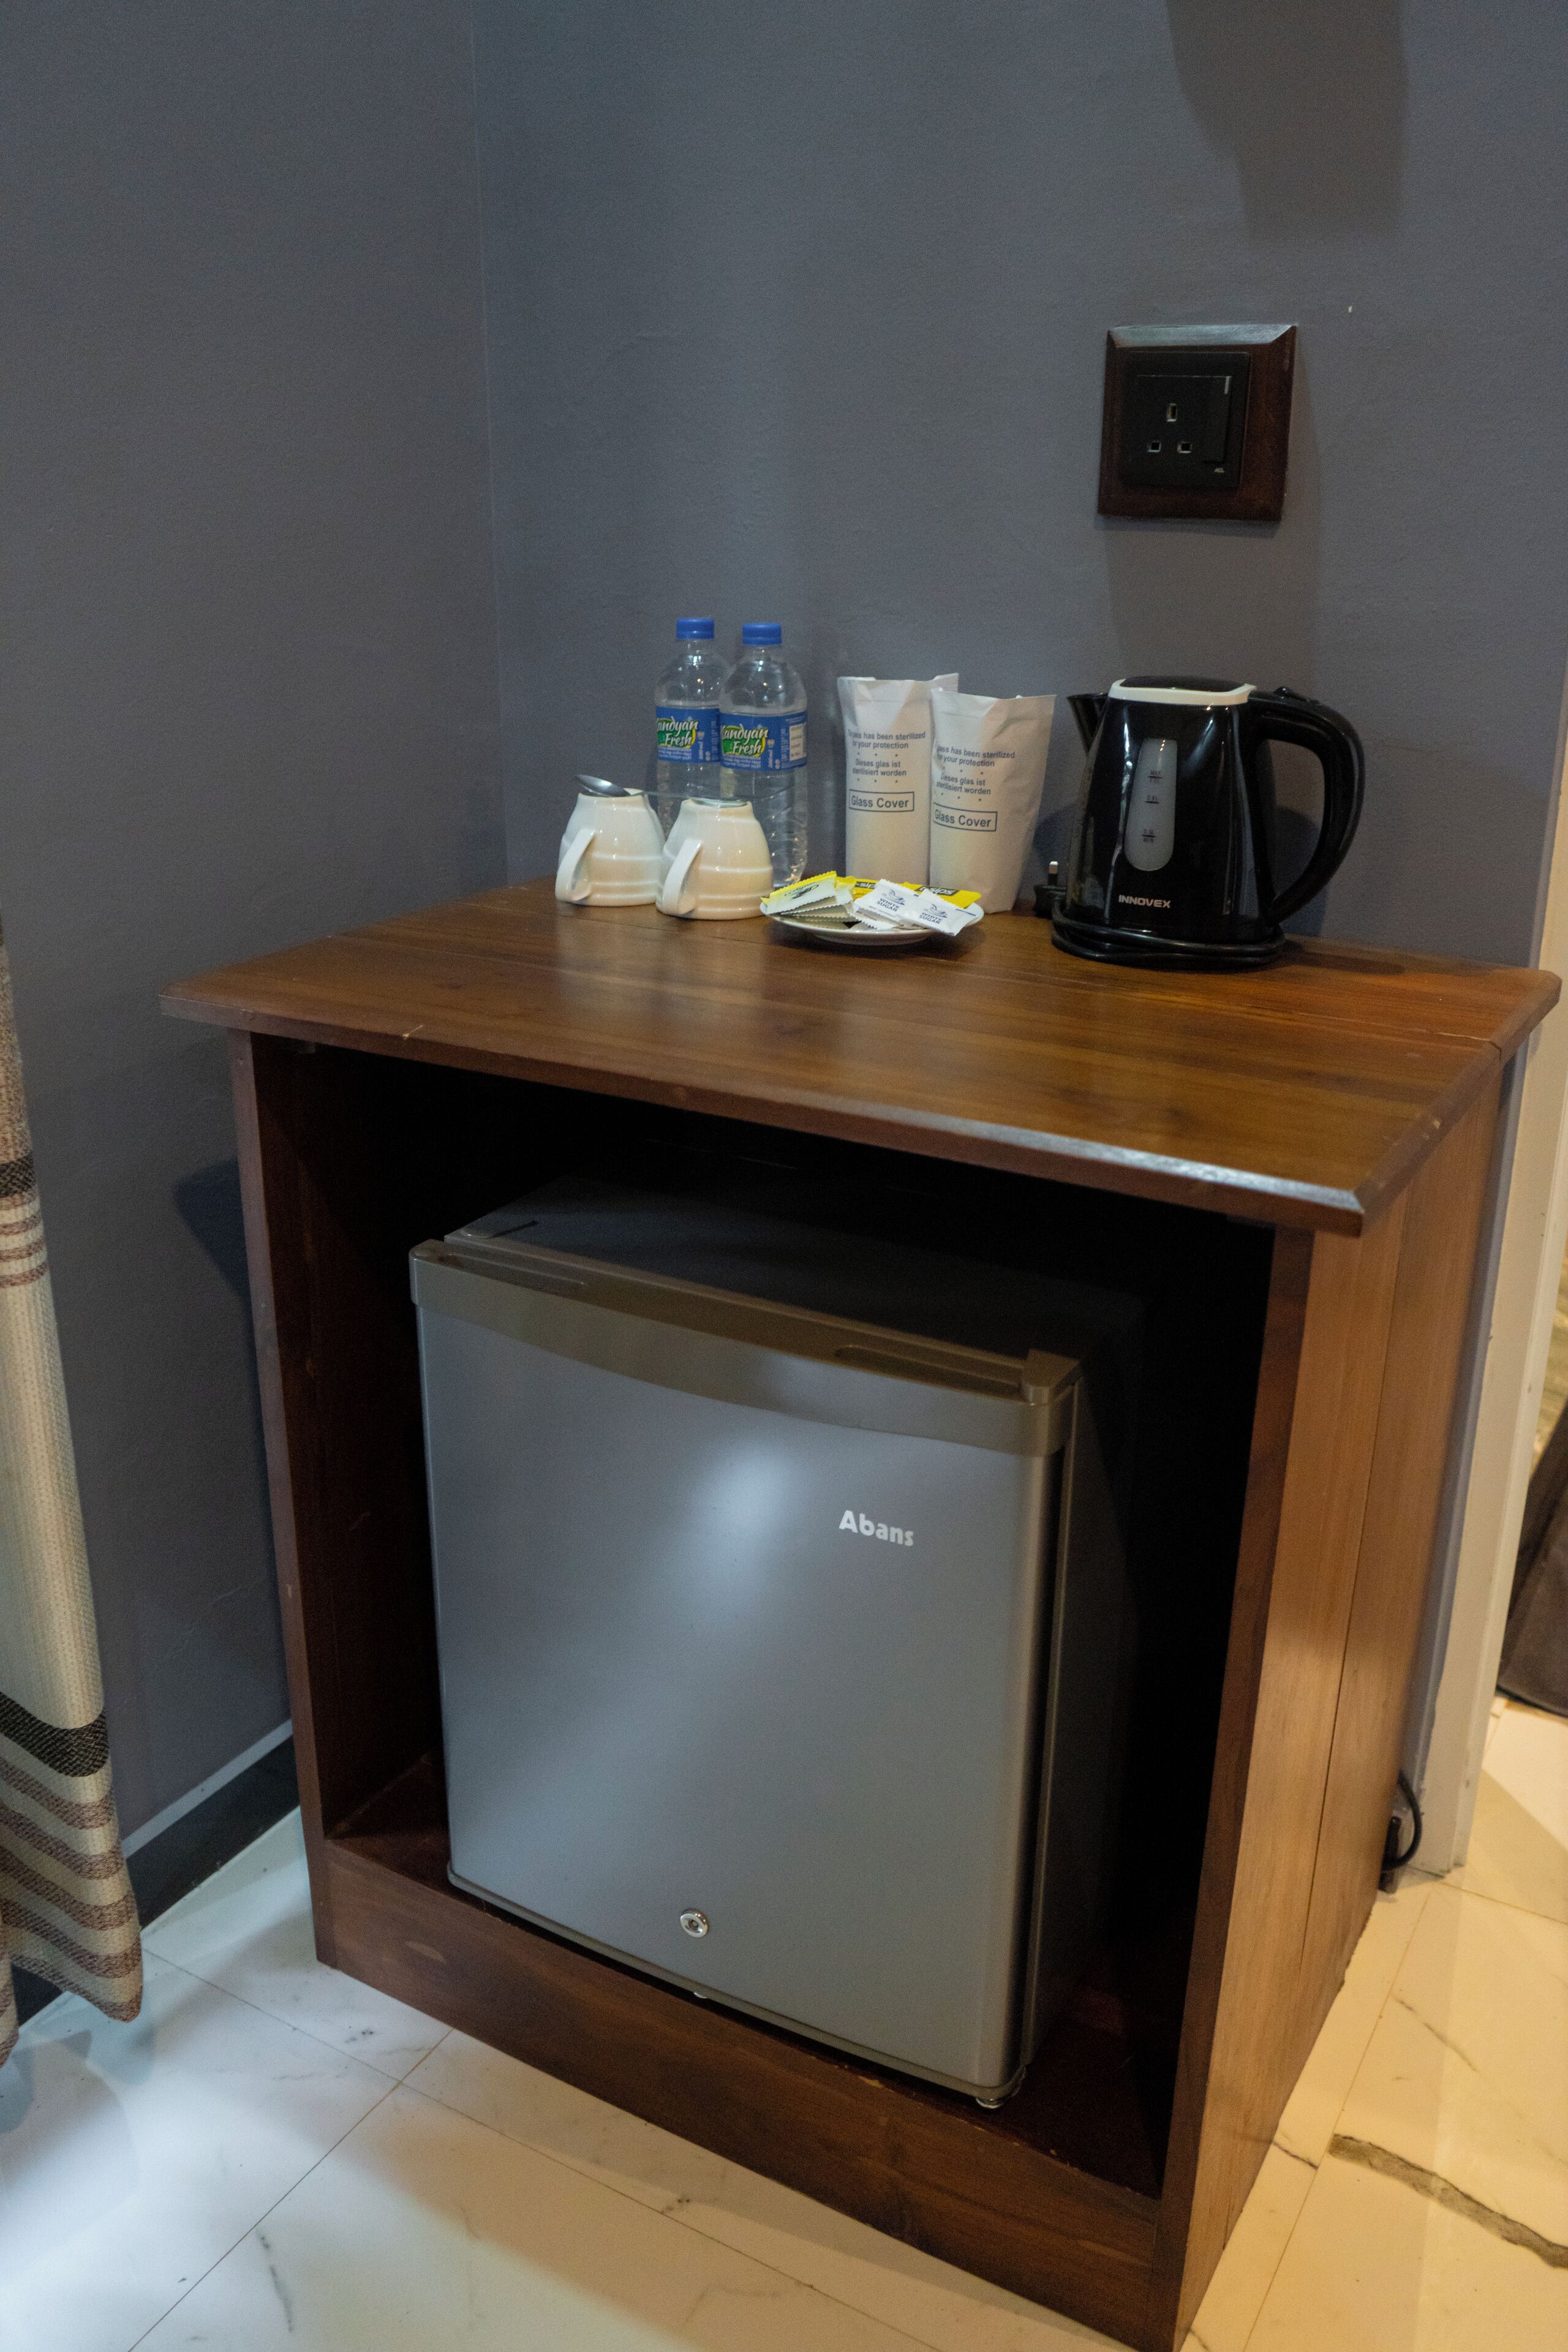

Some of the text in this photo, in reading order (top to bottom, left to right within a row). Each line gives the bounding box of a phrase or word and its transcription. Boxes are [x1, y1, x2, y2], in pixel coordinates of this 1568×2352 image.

[657, 715, 699, 737] andyan
[665, 731, 692, 747] Fresh
[733, 739, 762, 754] Fresh
[963, 749, 980, 758] been
[959, 758, 995, 767] protection
[851, 795, 909, 808] Glass Cover
[935, 809, 992, 827] Glass Cover
[876, 900, 898, 911] SUGAR
[880, 897, 900, 908] WHITE
[1118, 894, 1171, 908] INNOVEX
[919, 914, 941, 924] SUGAR
[922, 912, 943, 921] WHITE
[839, 1509, 914, 1547] Abans
